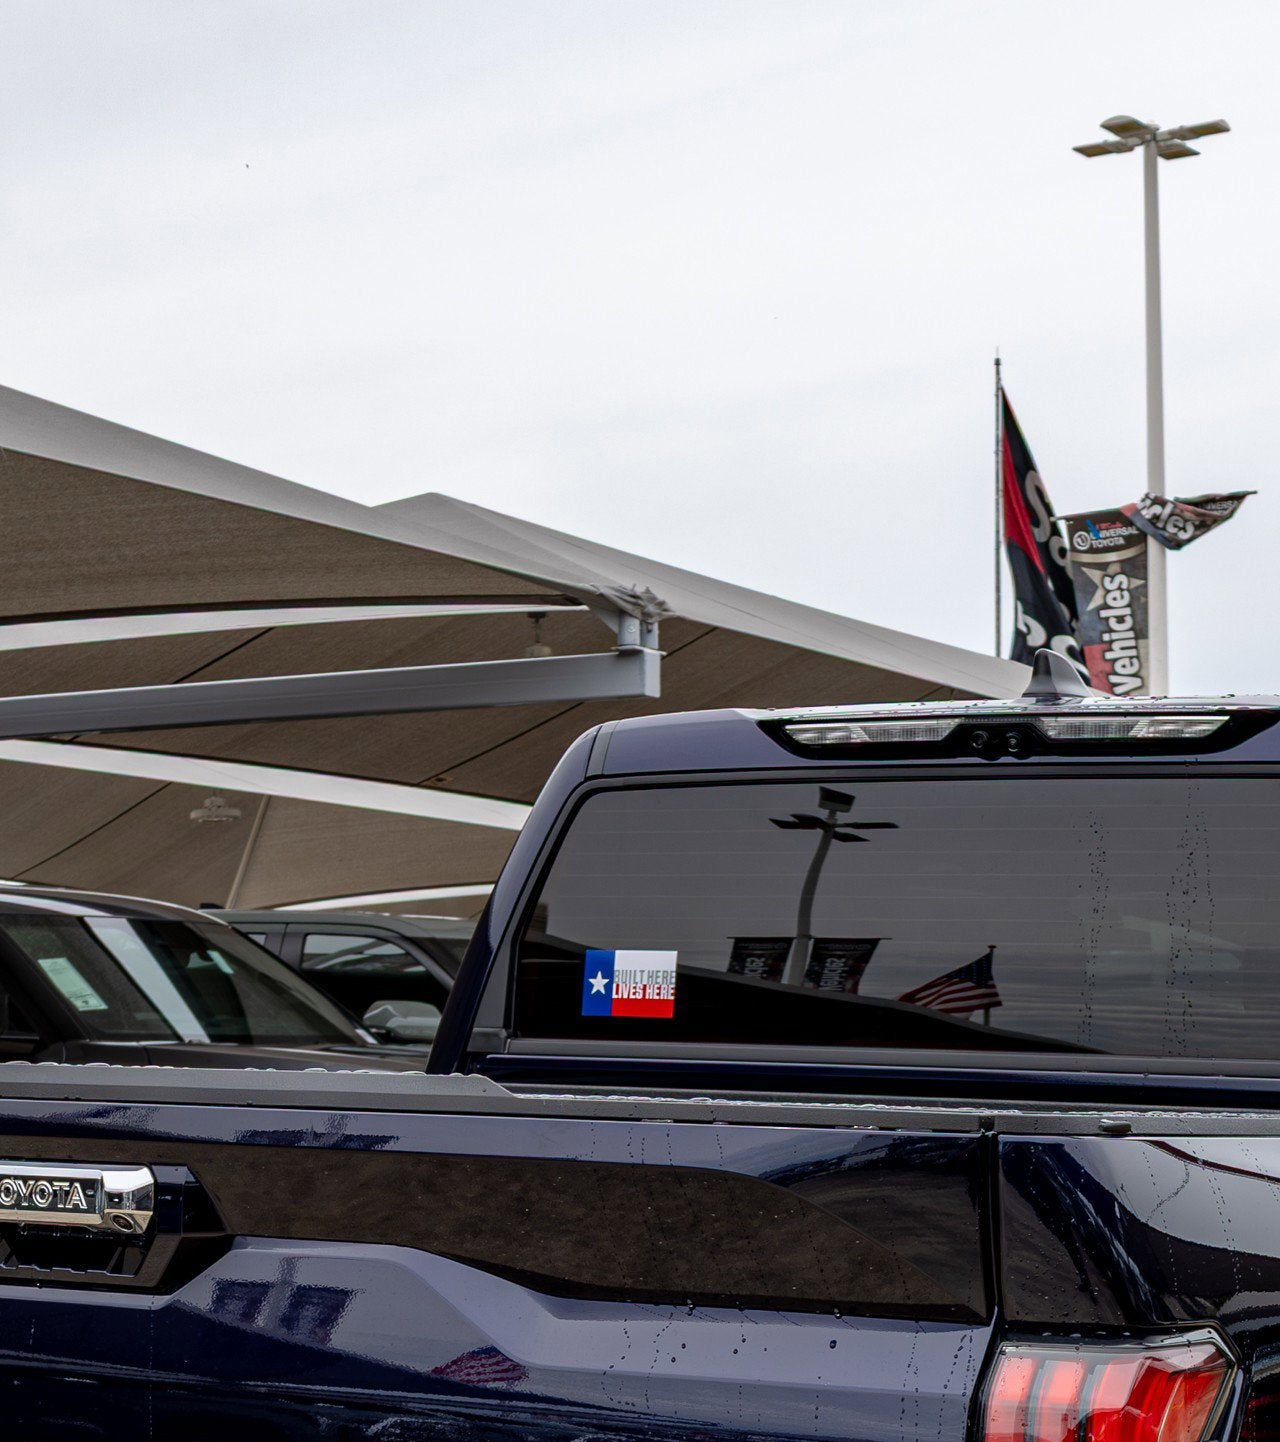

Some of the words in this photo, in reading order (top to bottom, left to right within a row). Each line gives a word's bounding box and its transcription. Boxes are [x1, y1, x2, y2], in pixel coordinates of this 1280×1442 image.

[1099, 573, 1143, 695] Vehicles
[613, 969, 646, 985] BUILT
[646, 969, 676, 986] HERE
[612, 983, 644, 999] LIVES
[645, 984, 675, 1000] HERE
